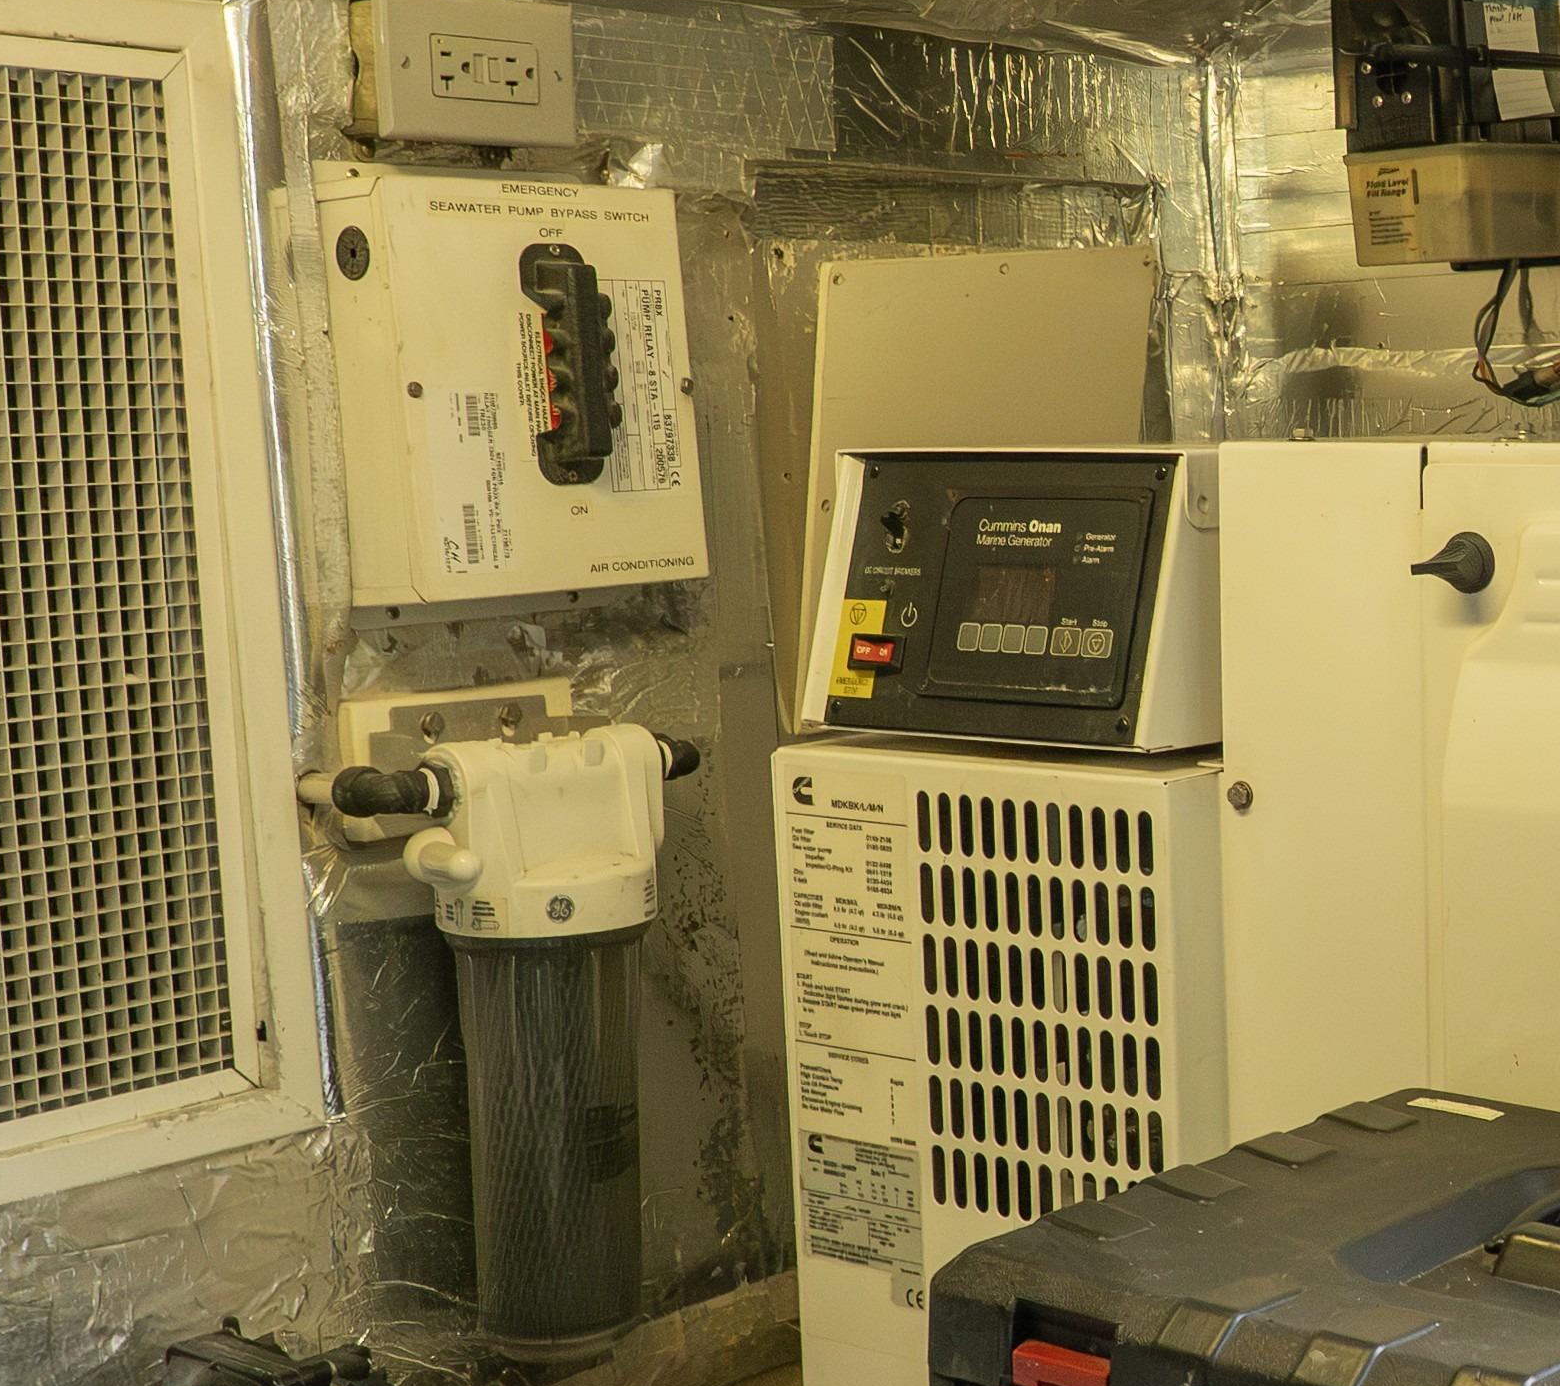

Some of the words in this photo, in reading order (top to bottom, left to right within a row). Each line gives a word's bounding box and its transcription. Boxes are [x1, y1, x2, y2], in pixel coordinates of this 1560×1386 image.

[500, 184, 579, 199] EMERGENCY
[429, 201, 502, 215] SEAWATER
[508, 204, 544, 217] PUMP
[550, 208, 600, 221] BYPASS
[604, 210, 650, 223] SWITCH
[539, 227, 564, 239] OFF
[641, 289, 650, 320] PUMP
[645, 325, 654, 358] RELAY
[649, 380, 658, 400] STA
[571, 505, 589, 515] ON
[979, 518, 1027, 533] Cummins
[1029, 519, 1062, 534] Onan
[976, 534, 1006, 546] Marine
[1007, 534, 1053, 548] Generator
[590, 563, 614, 574] AIR
[616, 555, 694, 571] CONDITIONING
